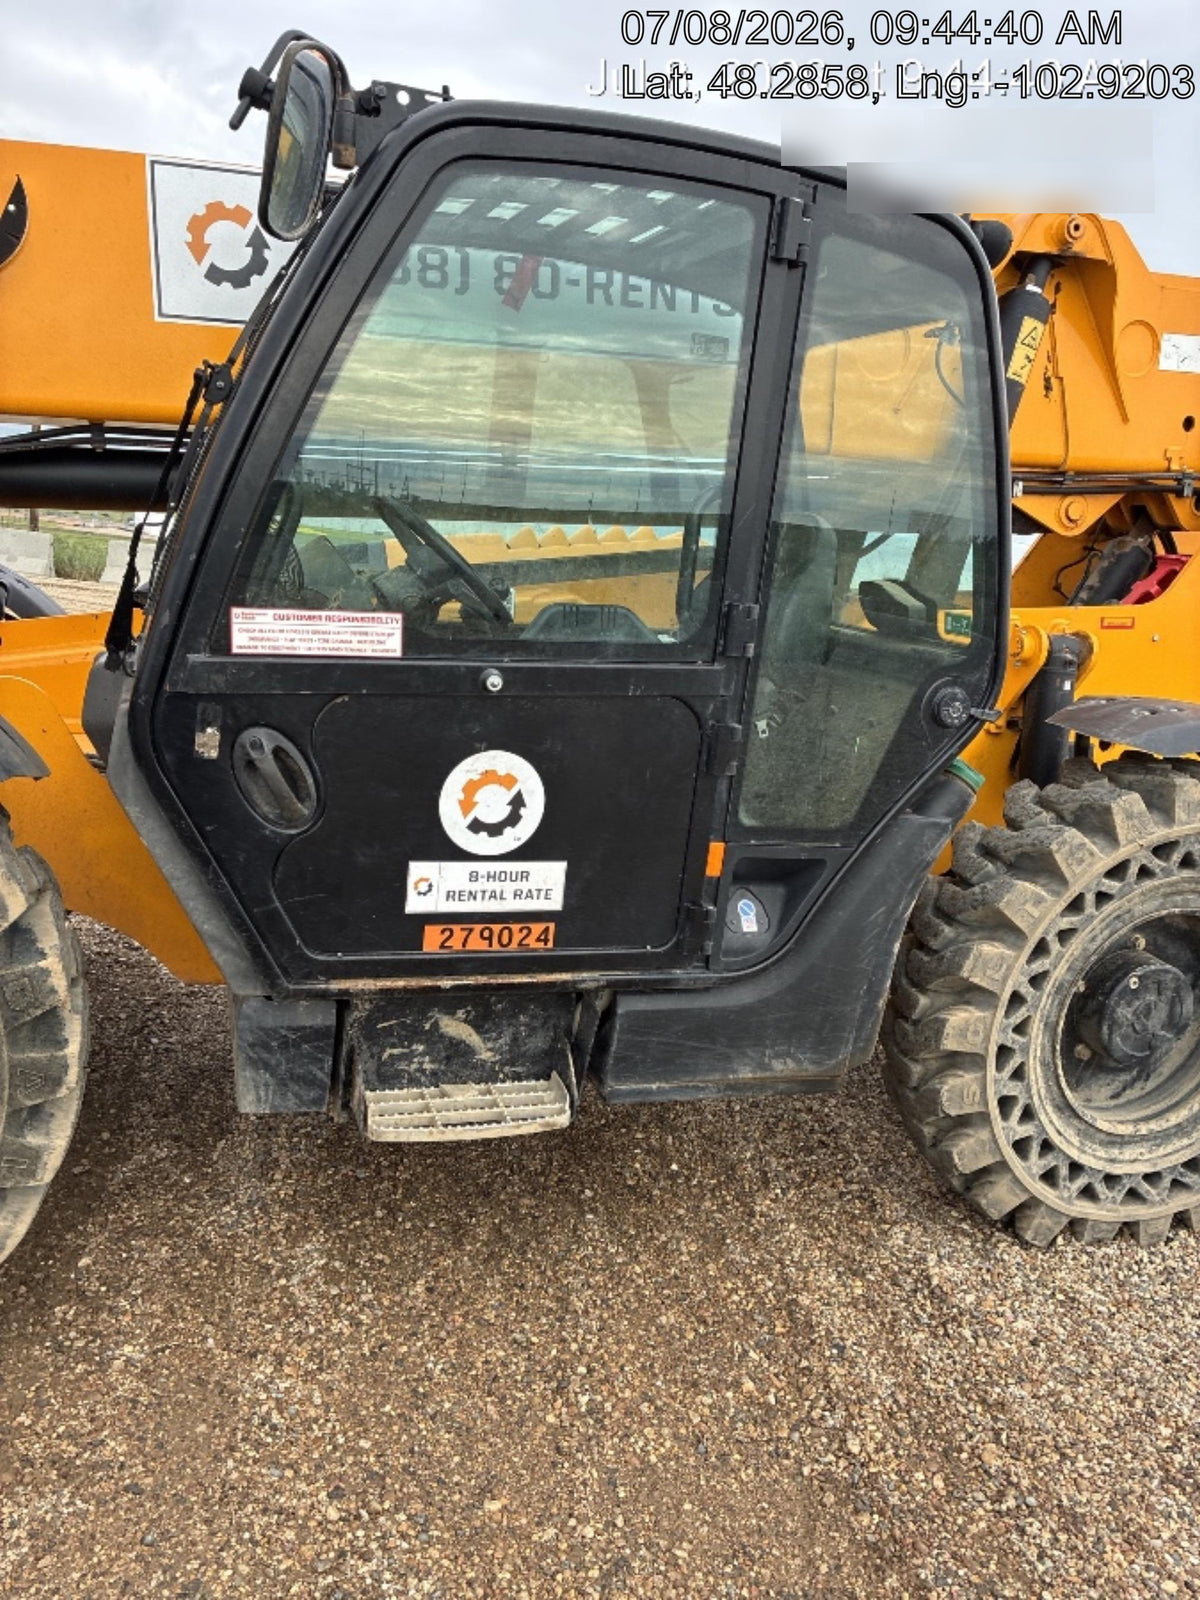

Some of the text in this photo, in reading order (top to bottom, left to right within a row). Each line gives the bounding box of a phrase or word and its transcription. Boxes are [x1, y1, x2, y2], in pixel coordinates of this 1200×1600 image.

[468, 869, 531, 884] 8-HOUR
[445, 888, 553, 903] RENTAL RATE
[438, 926, 551, 950] 279024
